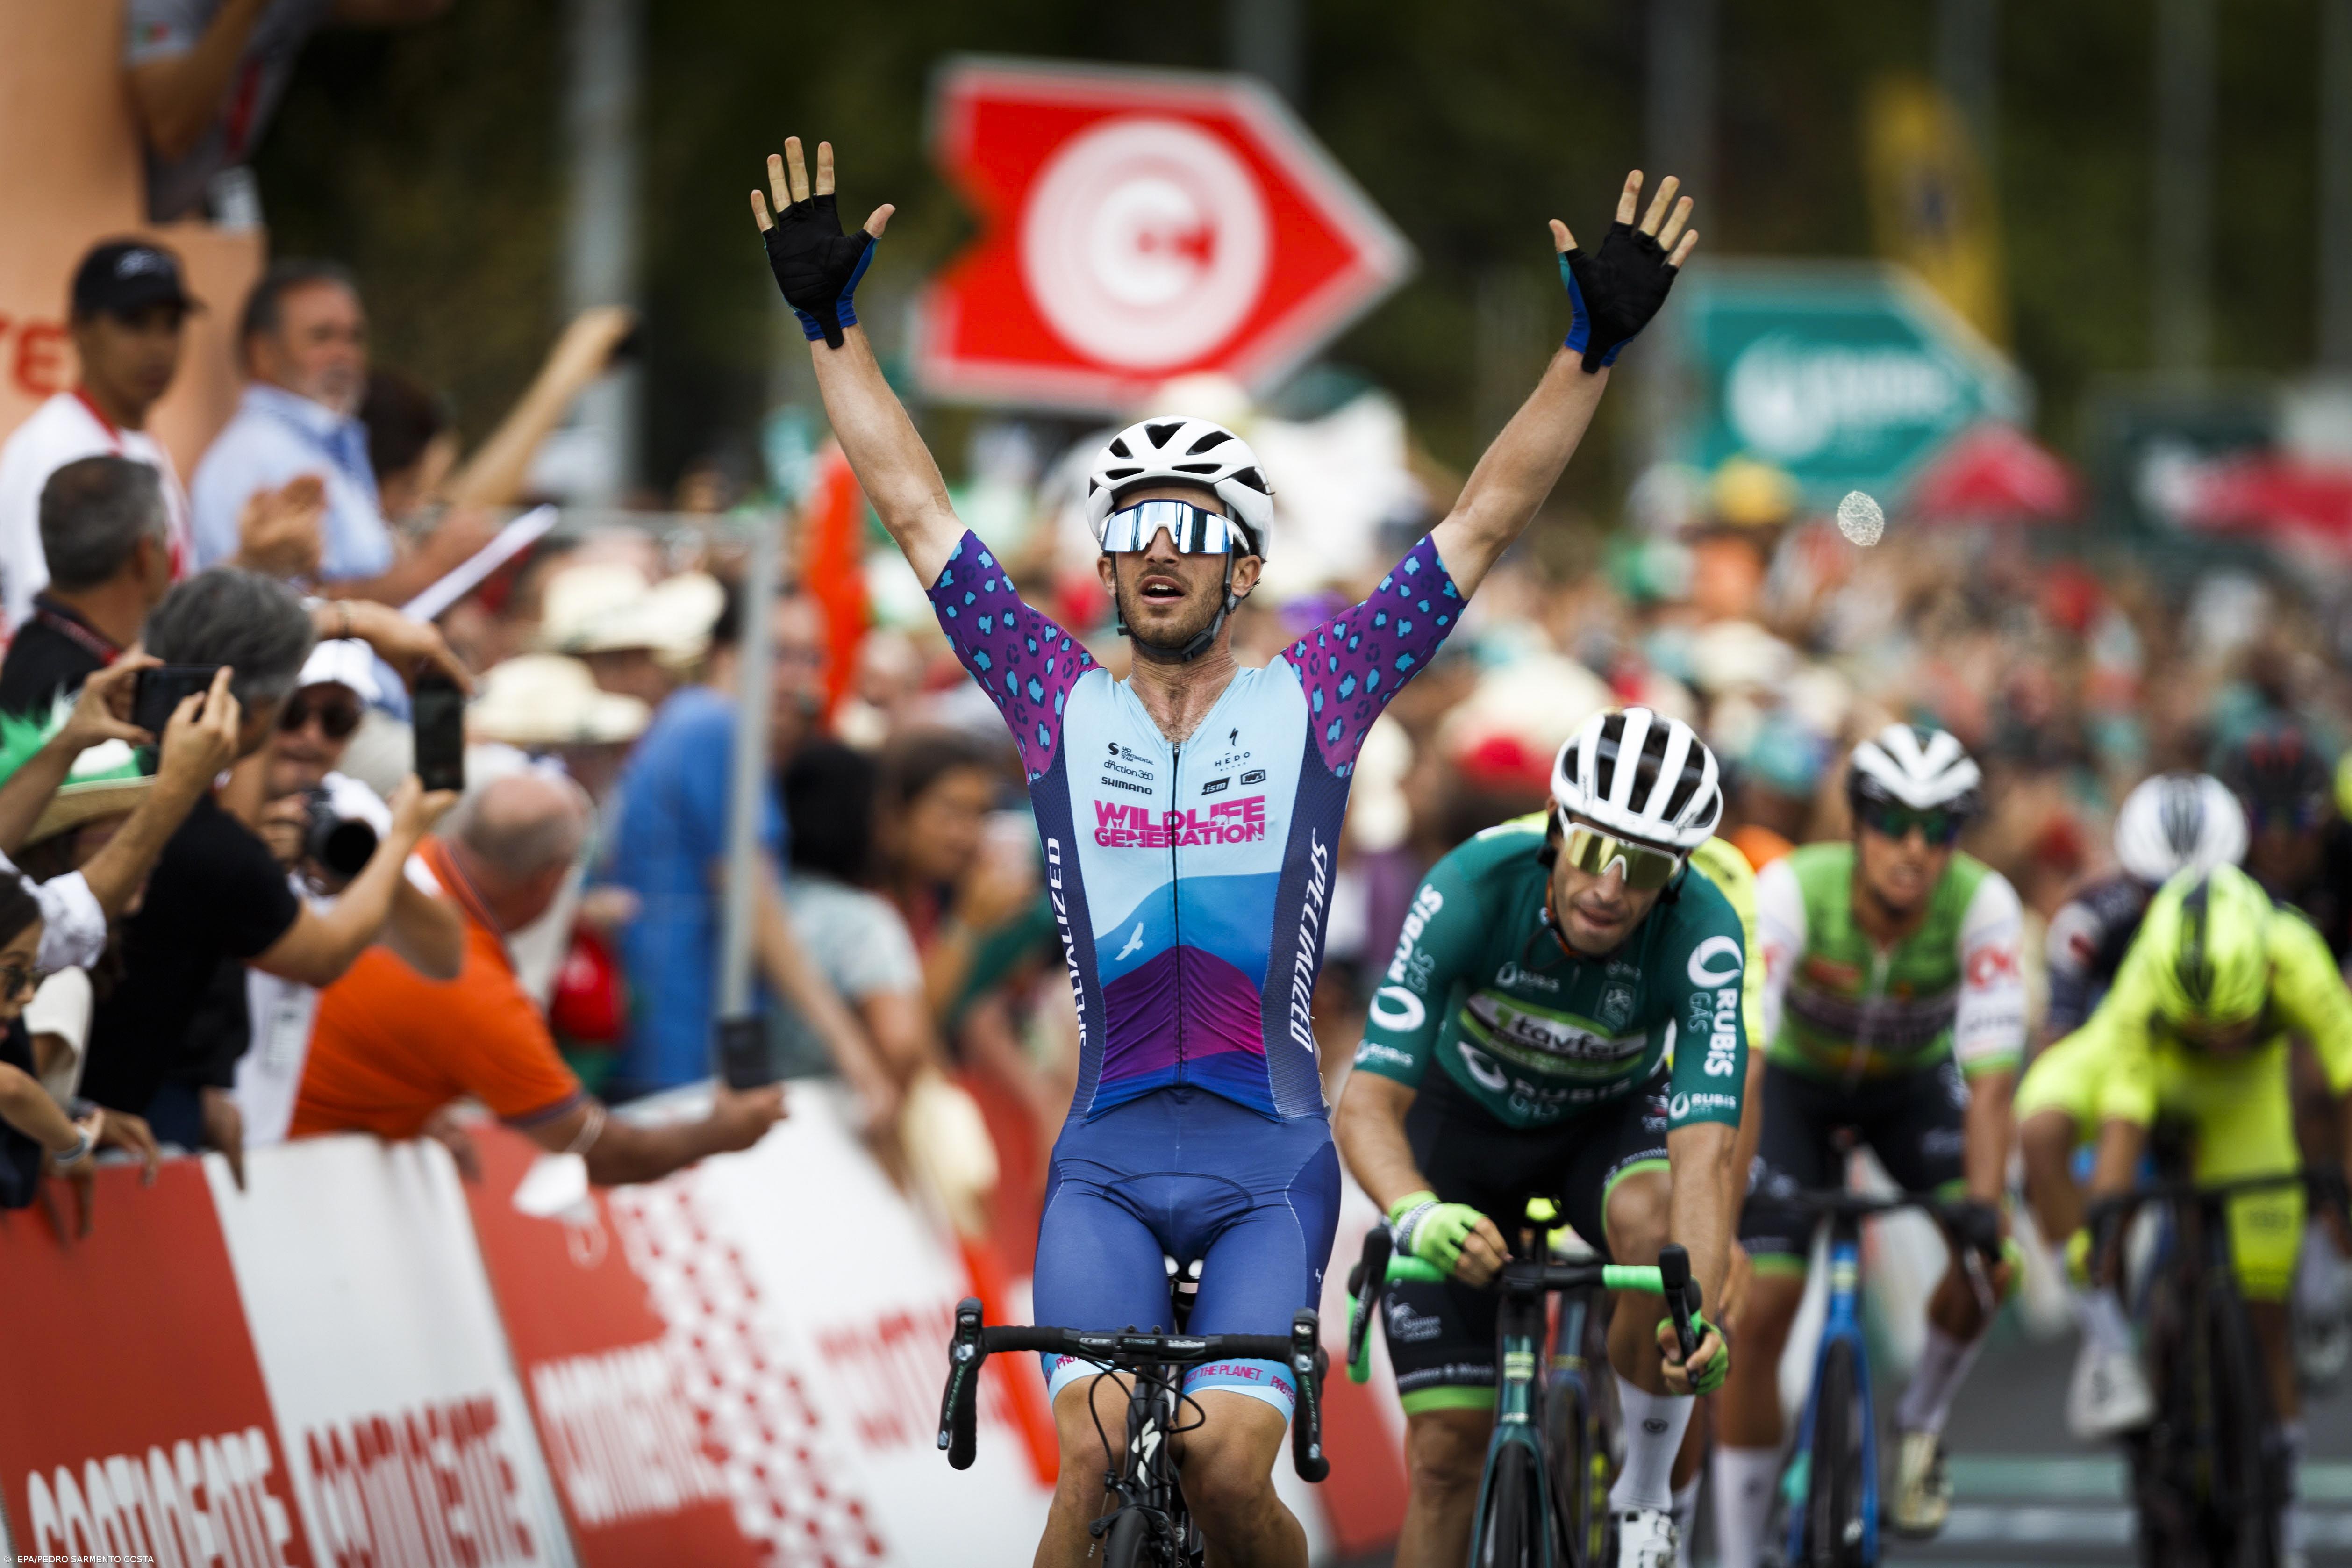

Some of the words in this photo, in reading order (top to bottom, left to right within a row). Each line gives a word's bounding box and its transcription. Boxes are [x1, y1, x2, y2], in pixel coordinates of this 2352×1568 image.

[1122, 751, 1154, 765] CONTINENTAL
[1101, 776, 1153, 795] SHIMANO
[1094, 795, 1265, 832] WILDLIFE
[1094, 820, 1265, 848] GENERATION
[1290, 827, 1328, 1053] SPECIALIZED
[1056, 1354, 1081, 1370] PRO
[1200, 1365, 1219, 1377] THE
[1219, 1364, 1263, 1381] PLANET
